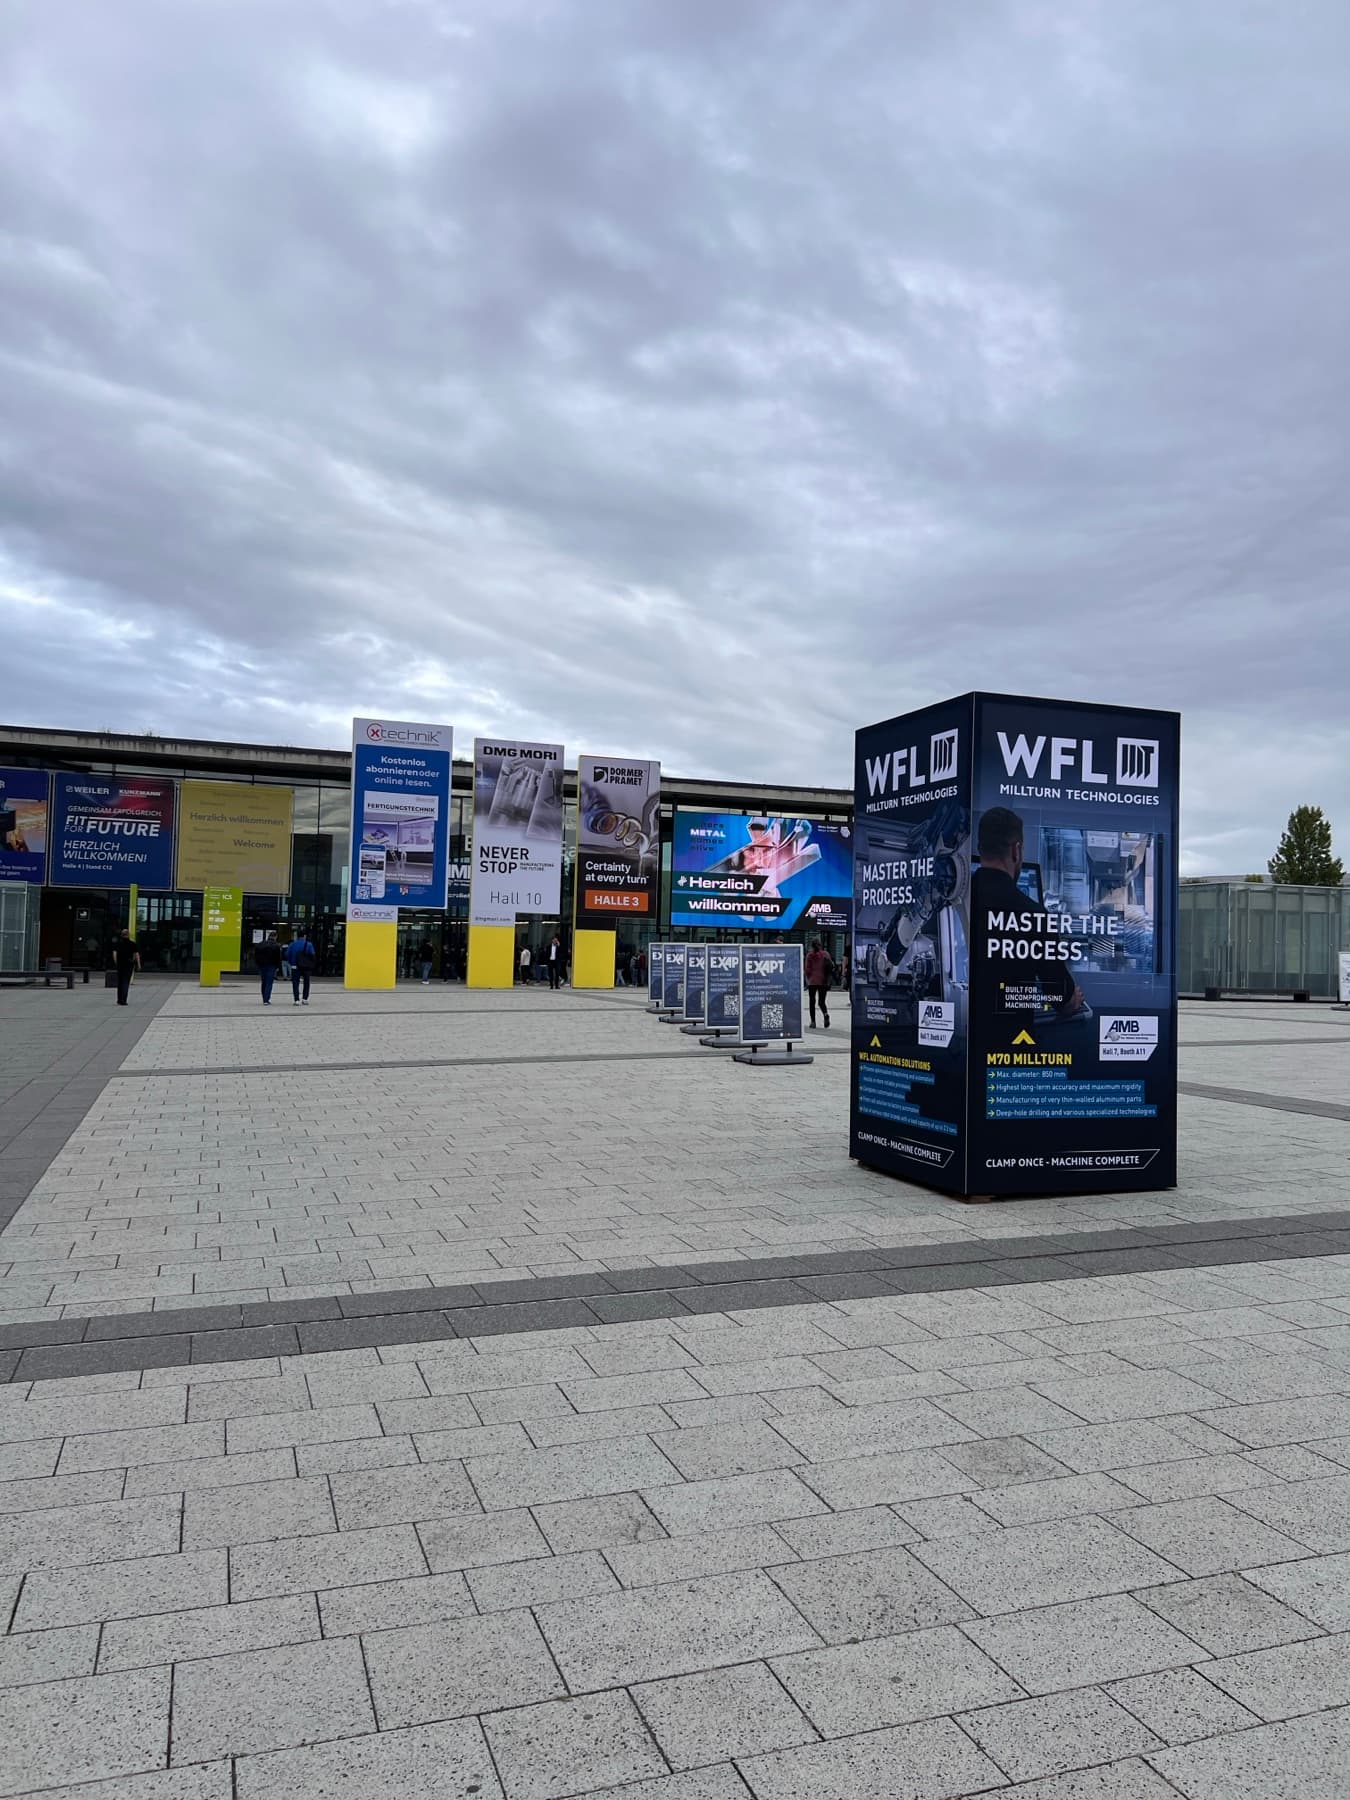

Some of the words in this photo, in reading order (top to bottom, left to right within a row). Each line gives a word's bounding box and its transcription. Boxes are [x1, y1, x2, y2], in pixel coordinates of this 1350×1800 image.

[483, 746, 517, 757] DMG
[520, 749, 557, 761] MORI
[997, 732, 1107, 785] WFL
[381, 756, 426, 767] Kostenlos
[366, 764, 418, 777] abonnieren
[419, 768, 440, 778] oder
[610, 767, 643, 778] DORMER
[865, 745, 926, 797] WFL
[374, 777, 403, 786] online
[405, 778, 432, 788] lesen.
[610, 775, 642, 786] PRAMET
[74, 786, 110, 795] WEILER
[1000, 783, 1061, 798] MILLTURN
[1066, 789, 1159, 805] TECHNOLOGIES
[866, 798, 899, 813] MILLTURN
[901, 785, 958, 806] TECHNOLOGIES
[367, 803, 435, 813] FERTIGUNGSTECHNIK
[66, 815, 88, 825] FIT
[190, 812, 227, 822] Herzlich
[229, 815, 284, 825] willkommen
[64, 825, 84, 833] FOR
[86, 820, 160, 837] FUTURE
[690, 829, 726, 838] METAL
[63, 840, 120, 851] HERZLICH
[233, 840, 275, 848] Welcome
[63, 850, 147, 862] WILLKOMMEN!
[480, 846, 529, 860] NEVER
[480, 860, 517, 874] STOP
[585, 861, 631, 874] Certainty
[863, 860, 908, 882] MASTER
[910, 856, 934, 878] THE
[585, 873, 595, 882] at
[598, 874, 625, 885] every
[690, 876, 754, 891] Herzlich
[490, 891, 520, 905] Hall
[526, 892, 542, 906] 10
[594, 895, 630, 906] HALLE
[632, 896, 640, 907] 3
[862, 886, 916, 906] PROCESS.
[688, 898, 780, 913] willkommen
[806, 903, 832, 914] AMB
[987, 910, 1073, 934] MASTER
[1079, 915, 1119, 935] THE
[987, 938, 1088, 961] PROCESS.
[666, 953, 684, 964] EXA
[710, 957, 739, 971] EXAP
[745, 960, 785, 976] EXAPT
[1005, 994, 1063, 1002] UNCOMPROMISING
[923, 1005, 943, 1019] AMB
[1107, 1020, 1140, 1034] AMB
[1103, 1047, 1113, 1055] Hall
[1120, 1047, 1135, 1055] Booth
[1136, 1047, 1146, 1055] A11
[859, 1052, 870, 1060] WFL
[870, 1053, 901, 1065] AUTOMATION
[902, 1058, 931, 1071] SOLUTIONS
[987, 1053, 1010, 1065] M70
[1013, 1053, 1072, 1065] MILLTURN
[996, 1084, 1020, 1092] Highest
[1021, 1084, 1050, 1092] long-term
[1121, 1083, 1142, 1091] rigidity
[996, 1096, 1040, 1104] Manufacturing
[1126, 1096, 1142, 1104] parts
[995, 1109, 1027, 1117] Deep-hole
[1028, 1109, 1050, 1117] drilling
[1119, 1108, 1156, 1116] technologies
[858, 1131, 873, 1141] CLAMP
[873, 1136, 887, 1146] ONCE
[890, 1140, 914, 1155] MACHINE
[914, 1147, 941, 1161] COMPLETE
[986, 1159, 1016, 1168] CLAMP
[1018, 1158, 1044, 1167] ONCE
[1051, 1157, 1094, 1166] MACHINE
[1095, 1155, 1140, 1165] COMPLETE
